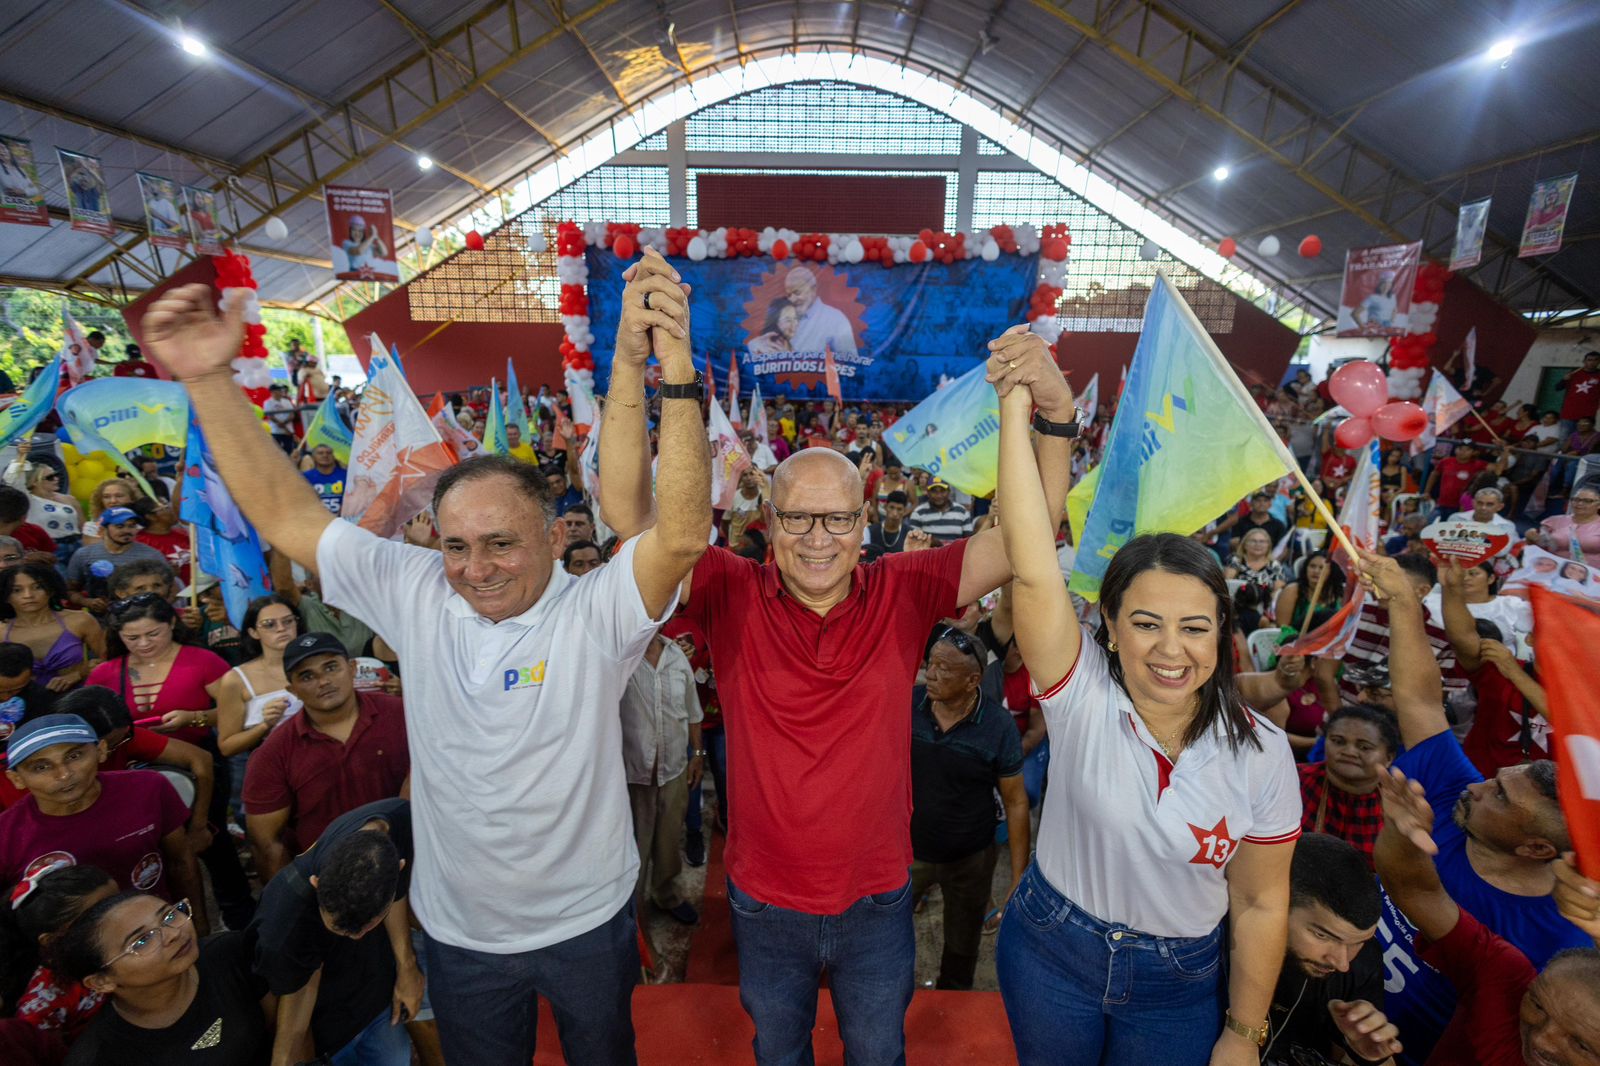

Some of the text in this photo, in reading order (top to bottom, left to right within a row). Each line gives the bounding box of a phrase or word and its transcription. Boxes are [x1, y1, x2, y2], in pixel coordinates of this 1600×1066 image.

[741, 353, 751, 365] A
[751, 351, 803, 363] esperança
[803, 351, 826, 361] para
[753, 360, 857, 377] BURITI DOS LPES
[504, 660, 545, 691] psd
[1202, 834, 1231, 863] 13
